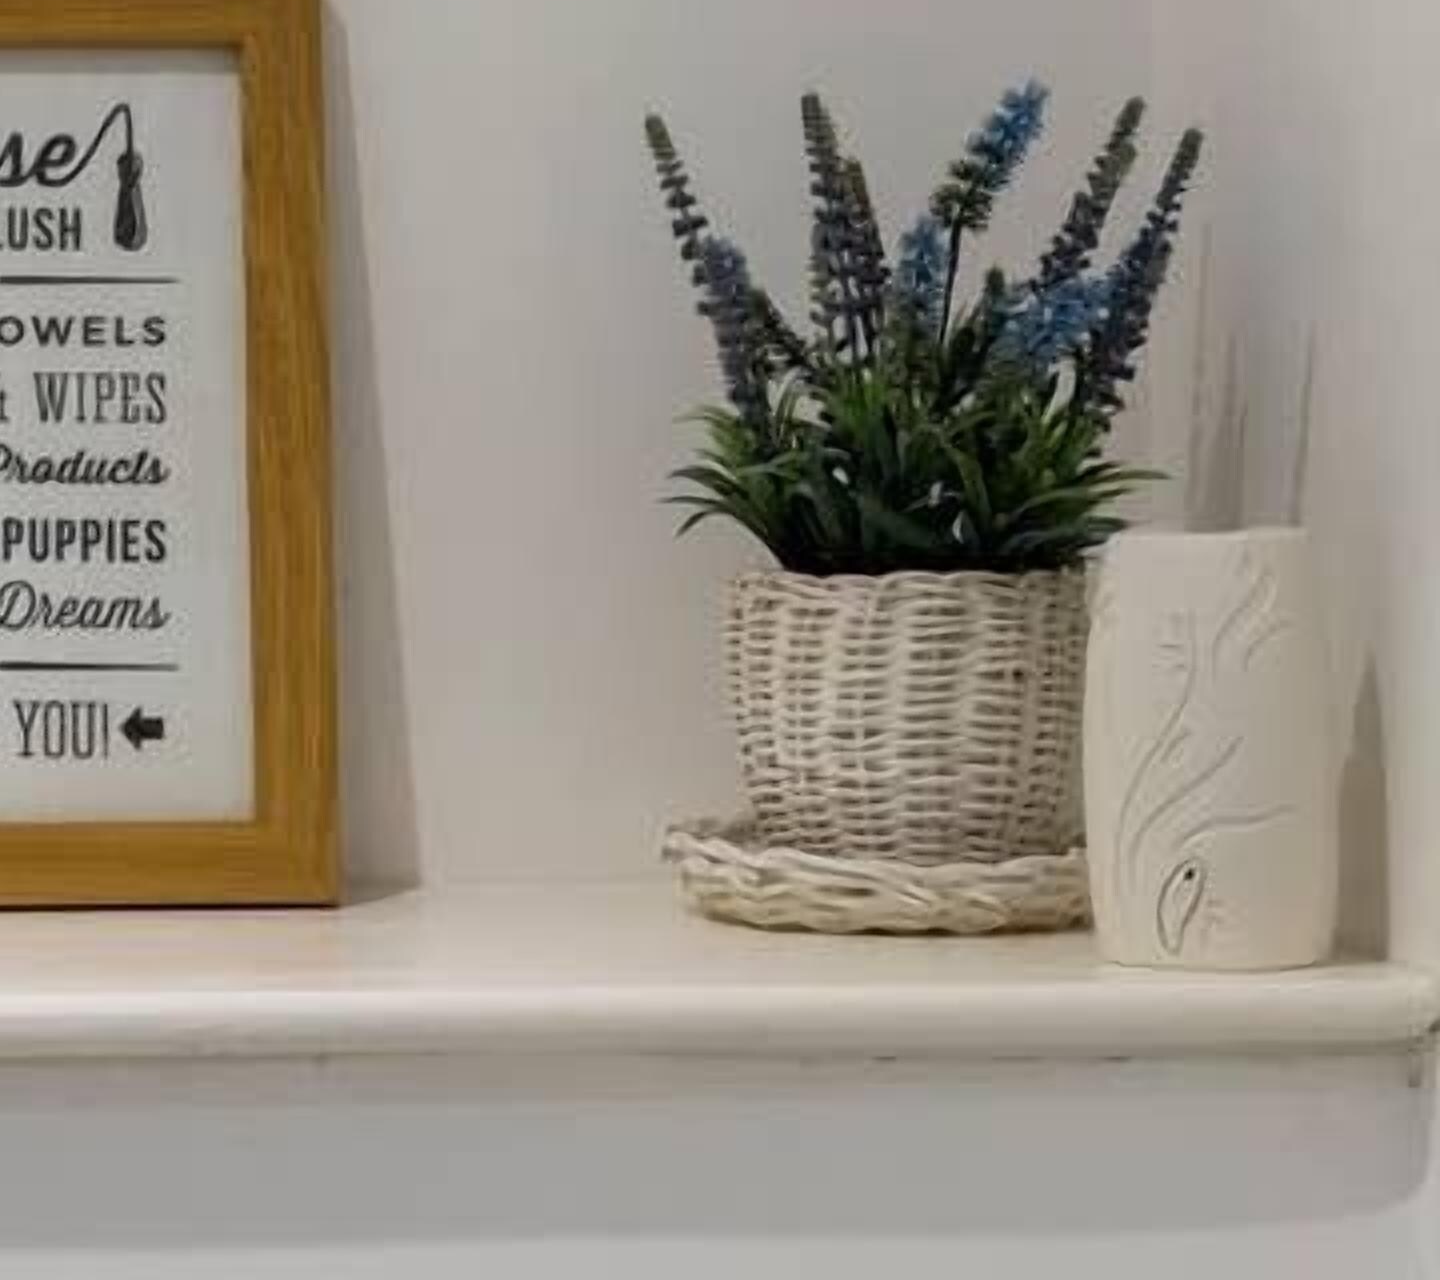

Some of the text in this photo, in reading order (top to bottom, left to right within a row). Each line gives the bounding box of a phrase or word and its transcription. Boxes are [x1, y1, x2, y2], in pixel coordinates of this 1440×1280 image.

[34, 369, 167, 424] WIPES
[2, 517, 167, 565] PUPPIES
[13, 700, 110, 760] YOU!
